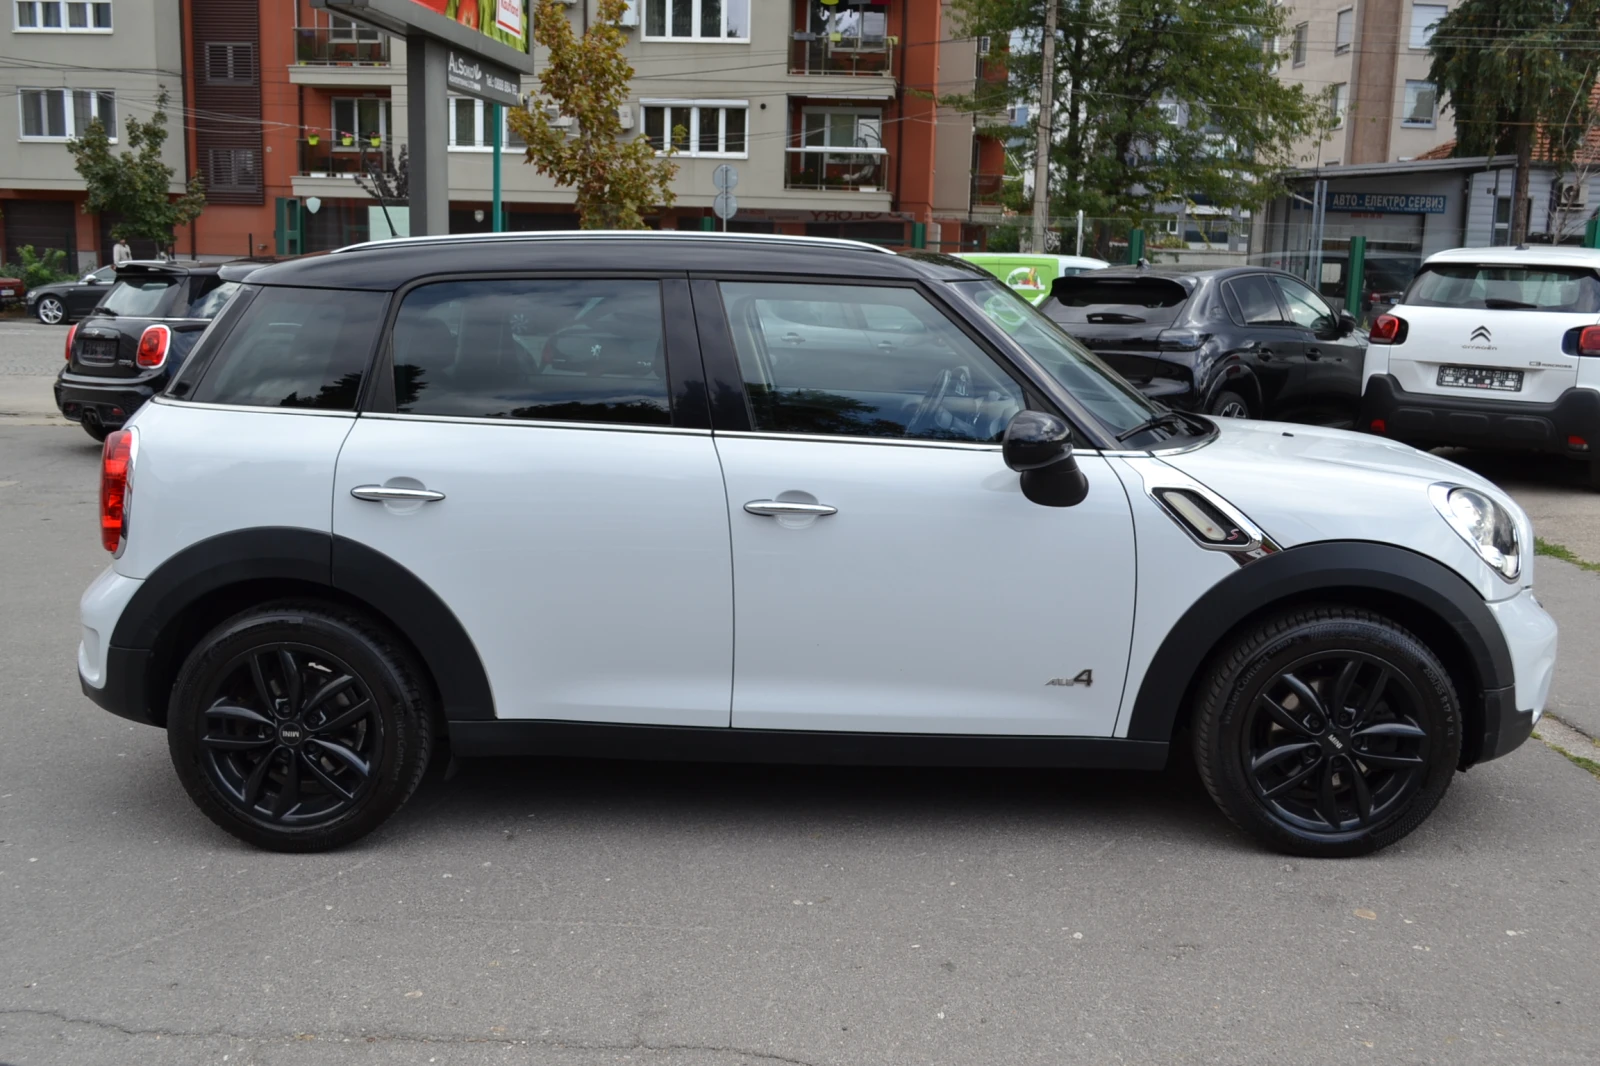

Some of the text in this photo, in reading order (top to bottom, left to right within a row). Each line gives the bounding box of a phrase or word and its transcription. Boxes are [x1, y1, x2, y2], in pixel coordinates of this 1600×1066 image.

[1333, 194, 1357, 206] АВТО
[1365, 195, 1406, 208] ЕЛЕКТРО
[1408, 196, 1444, 209] СЕРВИЗ
[1227, 528, 1240, 541] S
[1423, 667, 1446, 696] 205/55
[282, 730, 300, 738] MINI
[1328, 734, 1343, 749] MINI
